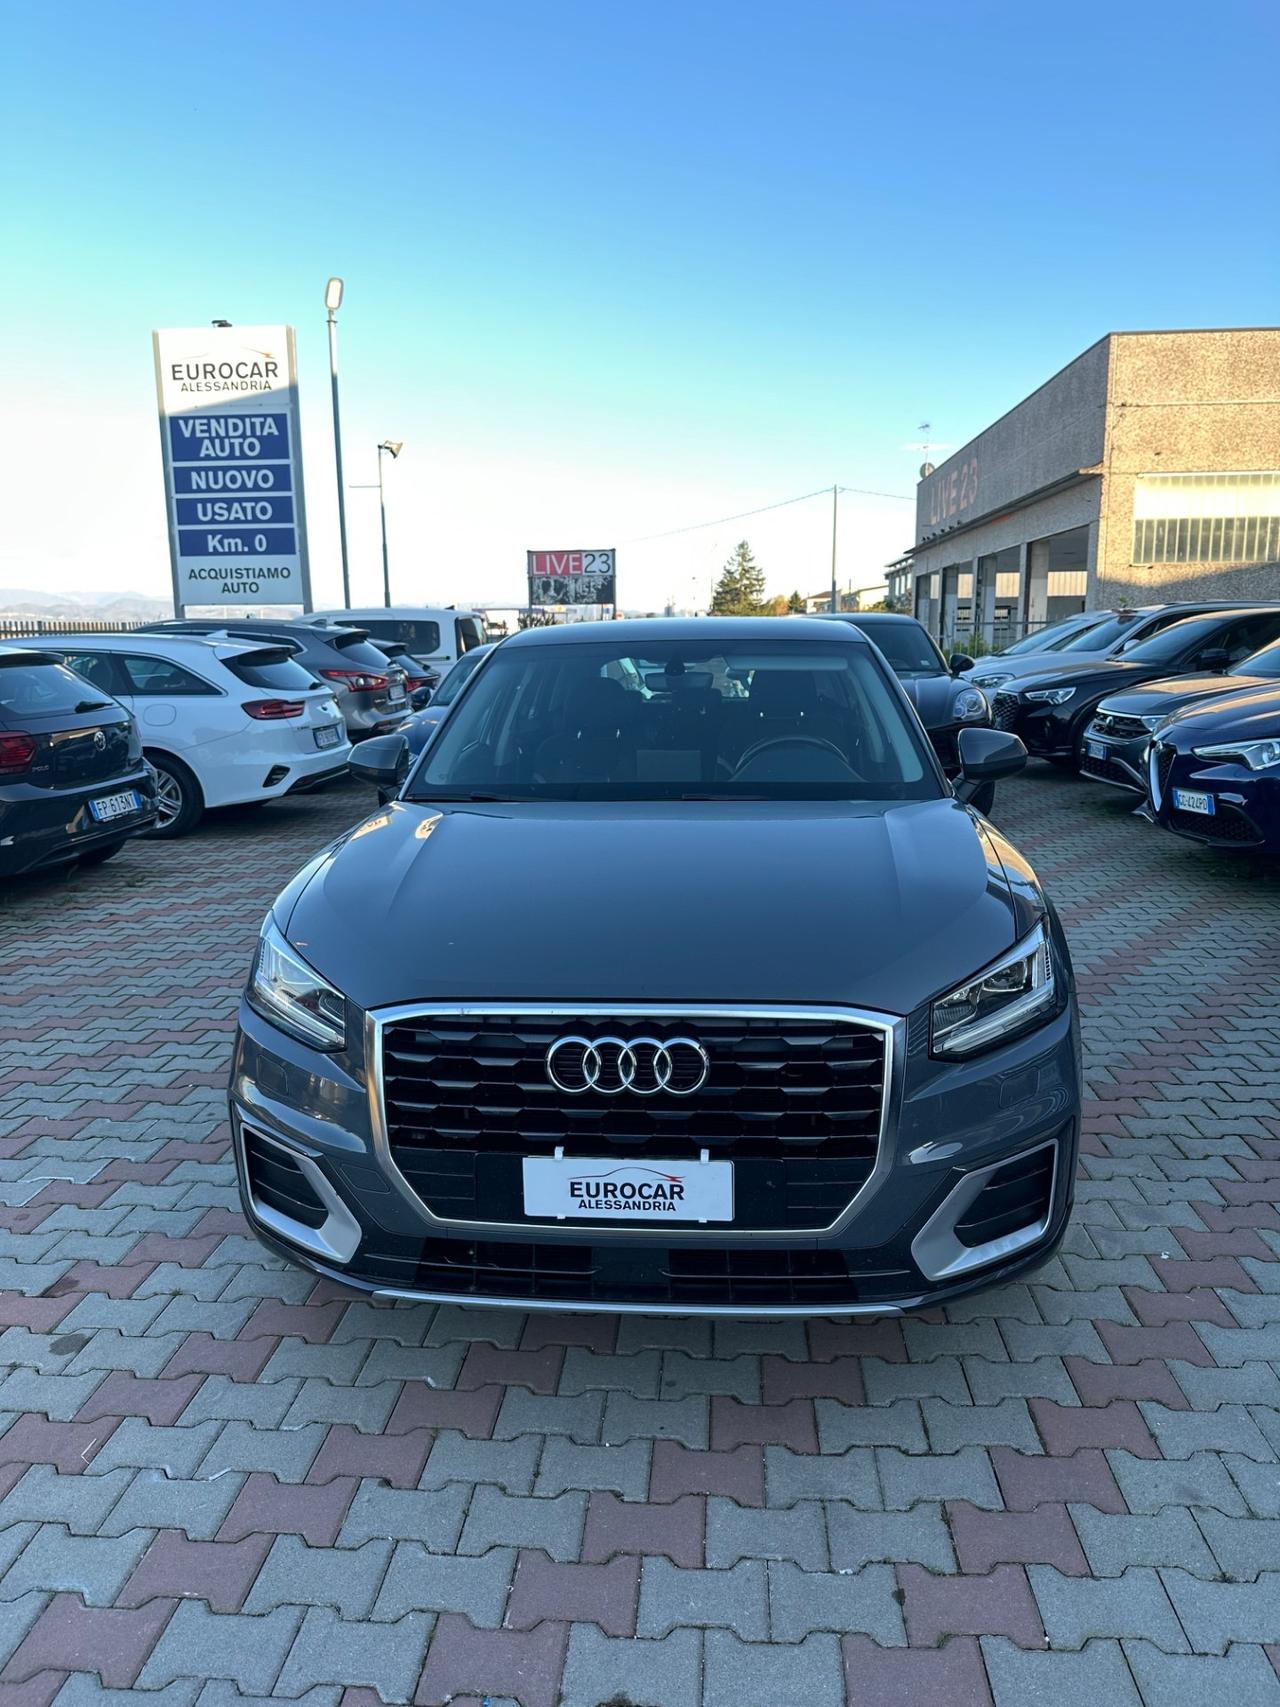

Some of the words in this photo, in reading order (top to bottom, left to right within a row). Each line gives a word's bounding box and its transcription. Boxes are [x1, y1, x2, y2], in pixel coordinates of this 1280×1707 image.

[171, 361, 279, 381] EUROCAR
[180, 380, 272, 392] ALESSANDRIA
[178, 416, 279, 438] VENDITA
[199, 437, 261, 458] AUTO
[190, 468, 274, 490] NUOVO
[196, 501, 273, 522] USATO
[207, 534, 249, 553] Km.
[254, 534, 268, 552] 0
[188, 566, 291, 580] ACQUISTIAMO
[221, 581, 260, 594] AUTO
[569, 1181, 685, 1200] EUROCAR
[578, 1199, 676, 1212] ALESSANDRIA
